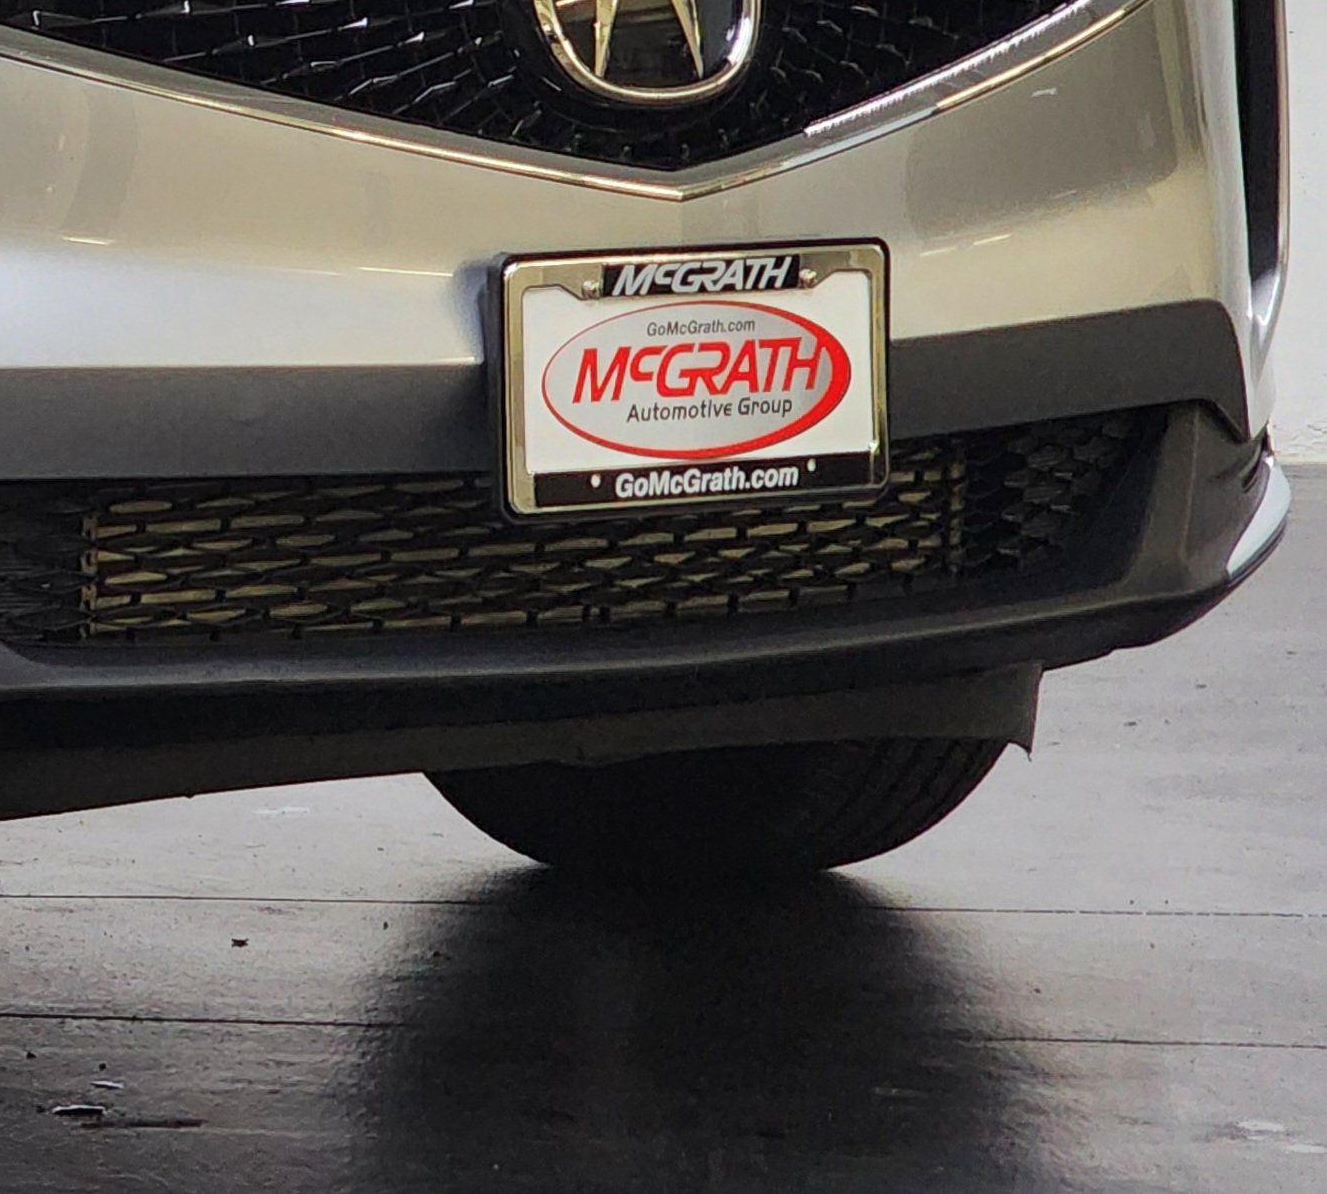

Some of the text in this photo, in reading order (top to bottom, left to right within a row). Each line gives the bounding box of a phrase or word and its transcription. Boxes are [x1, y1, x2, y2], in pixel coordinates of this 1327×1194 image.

[646, 318, 756, 337] GoMcGrath.com
[625, 396, 794, 424] Automotive Group
[614, 464, 800, 499] GoMcGrath.com
